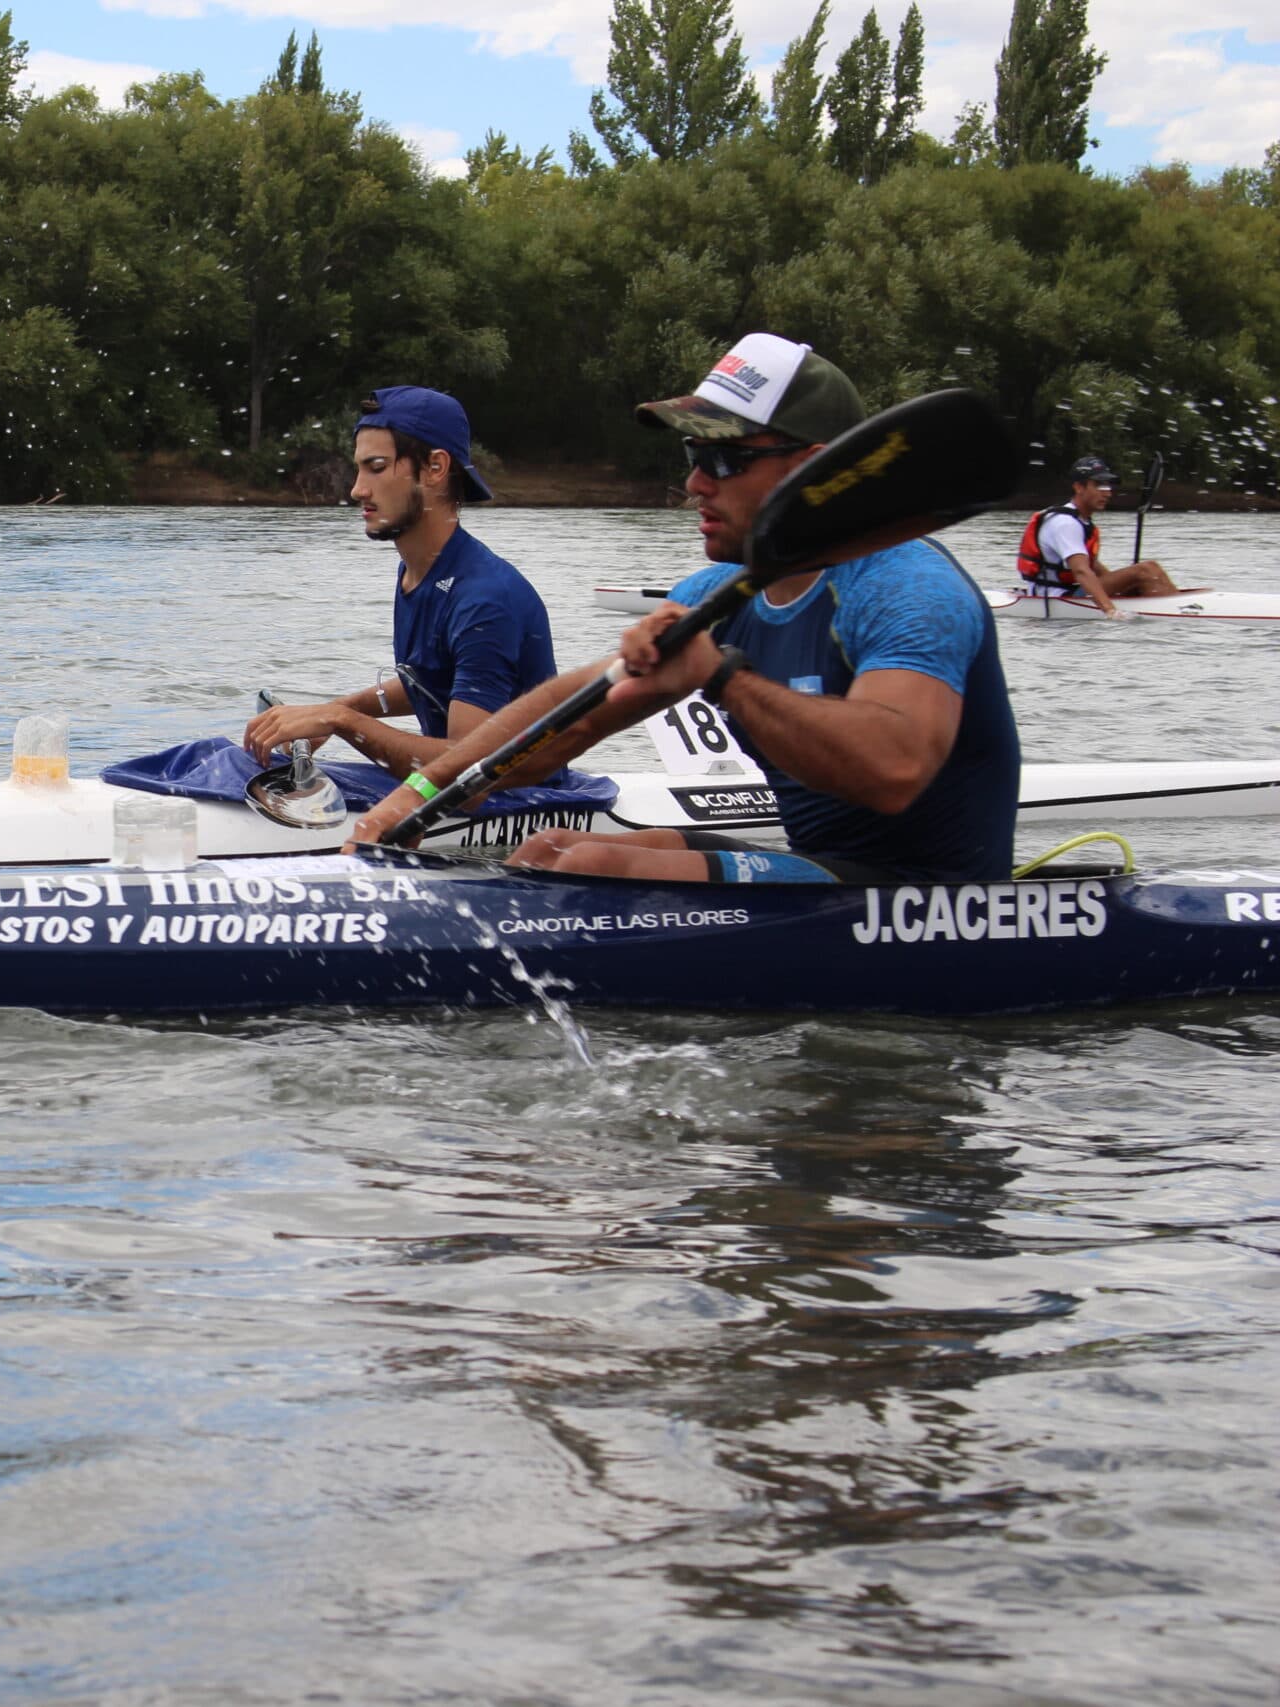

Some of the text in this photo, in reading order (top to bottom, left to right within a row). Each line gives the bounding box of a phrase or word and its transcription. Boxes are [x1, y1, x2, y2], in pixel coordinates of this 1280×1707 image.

[709, 807, 757, 816] AMBIENTE
[498, 909, 750, 934] CANOTAJE LAS FLORES
[851, 880, 1108, 945] J.CACERES
[107, 915, 134, 944] Y
[139, 912, 389, 945] AUTOPARTES
